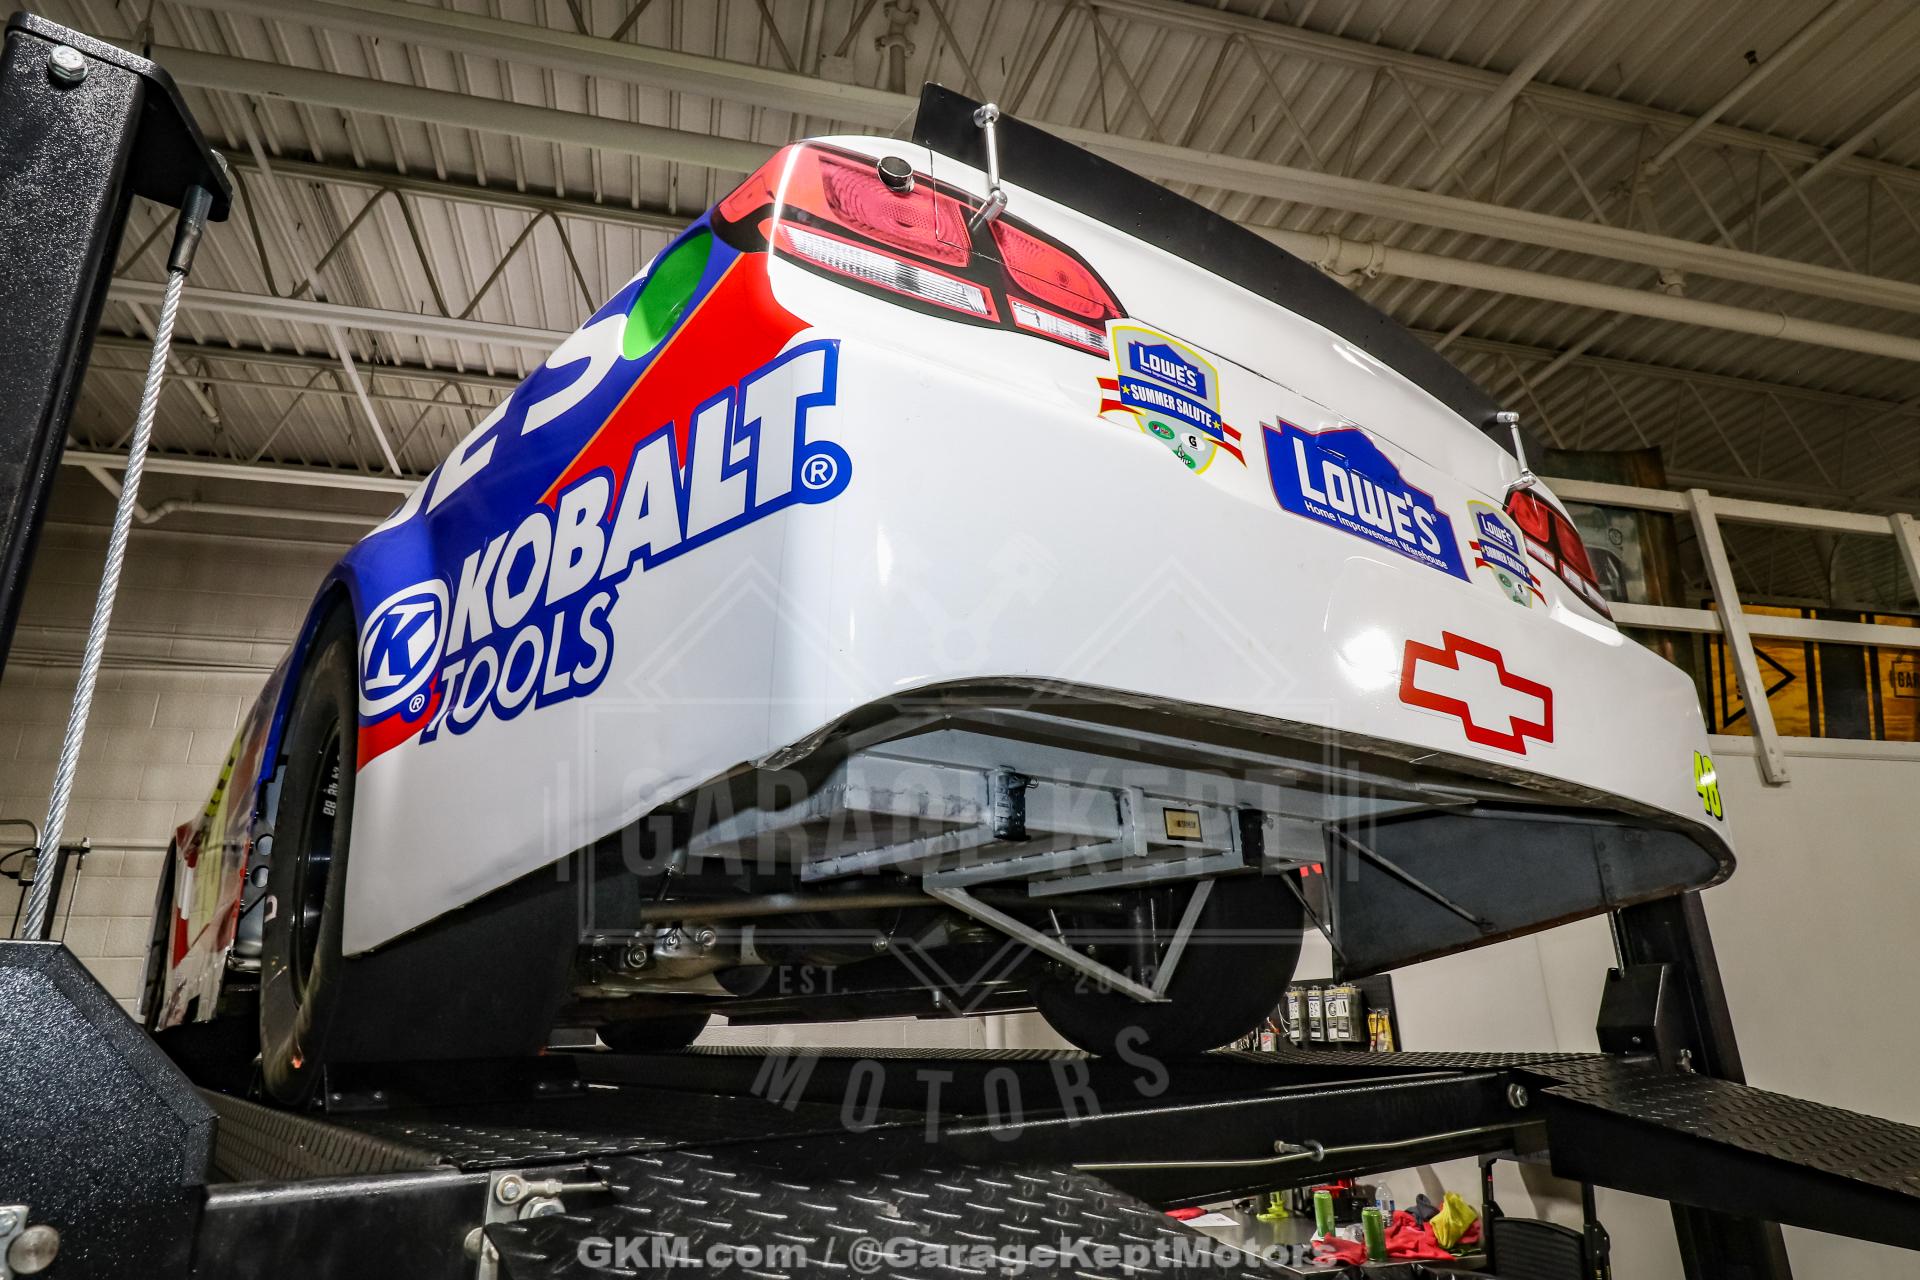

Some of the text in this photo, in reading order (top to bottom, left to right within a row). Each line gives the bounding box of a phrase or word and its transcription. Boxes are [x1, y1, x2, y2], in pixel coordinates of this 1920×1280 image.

[1138, 346, 1198, 387] LOWE'S
[1130, 384, 1212, 428] SUMMER SALUTE
[446, 349, 826, 657] KOBALT
[1293, 437, 1441, 555] LOWE'S
[1481, 515, 1514, 546] LOWE'S
[1304, 500, 1449, 571] Home Improvement Warehouse
[427, 591, 612, 733] TOOLS
